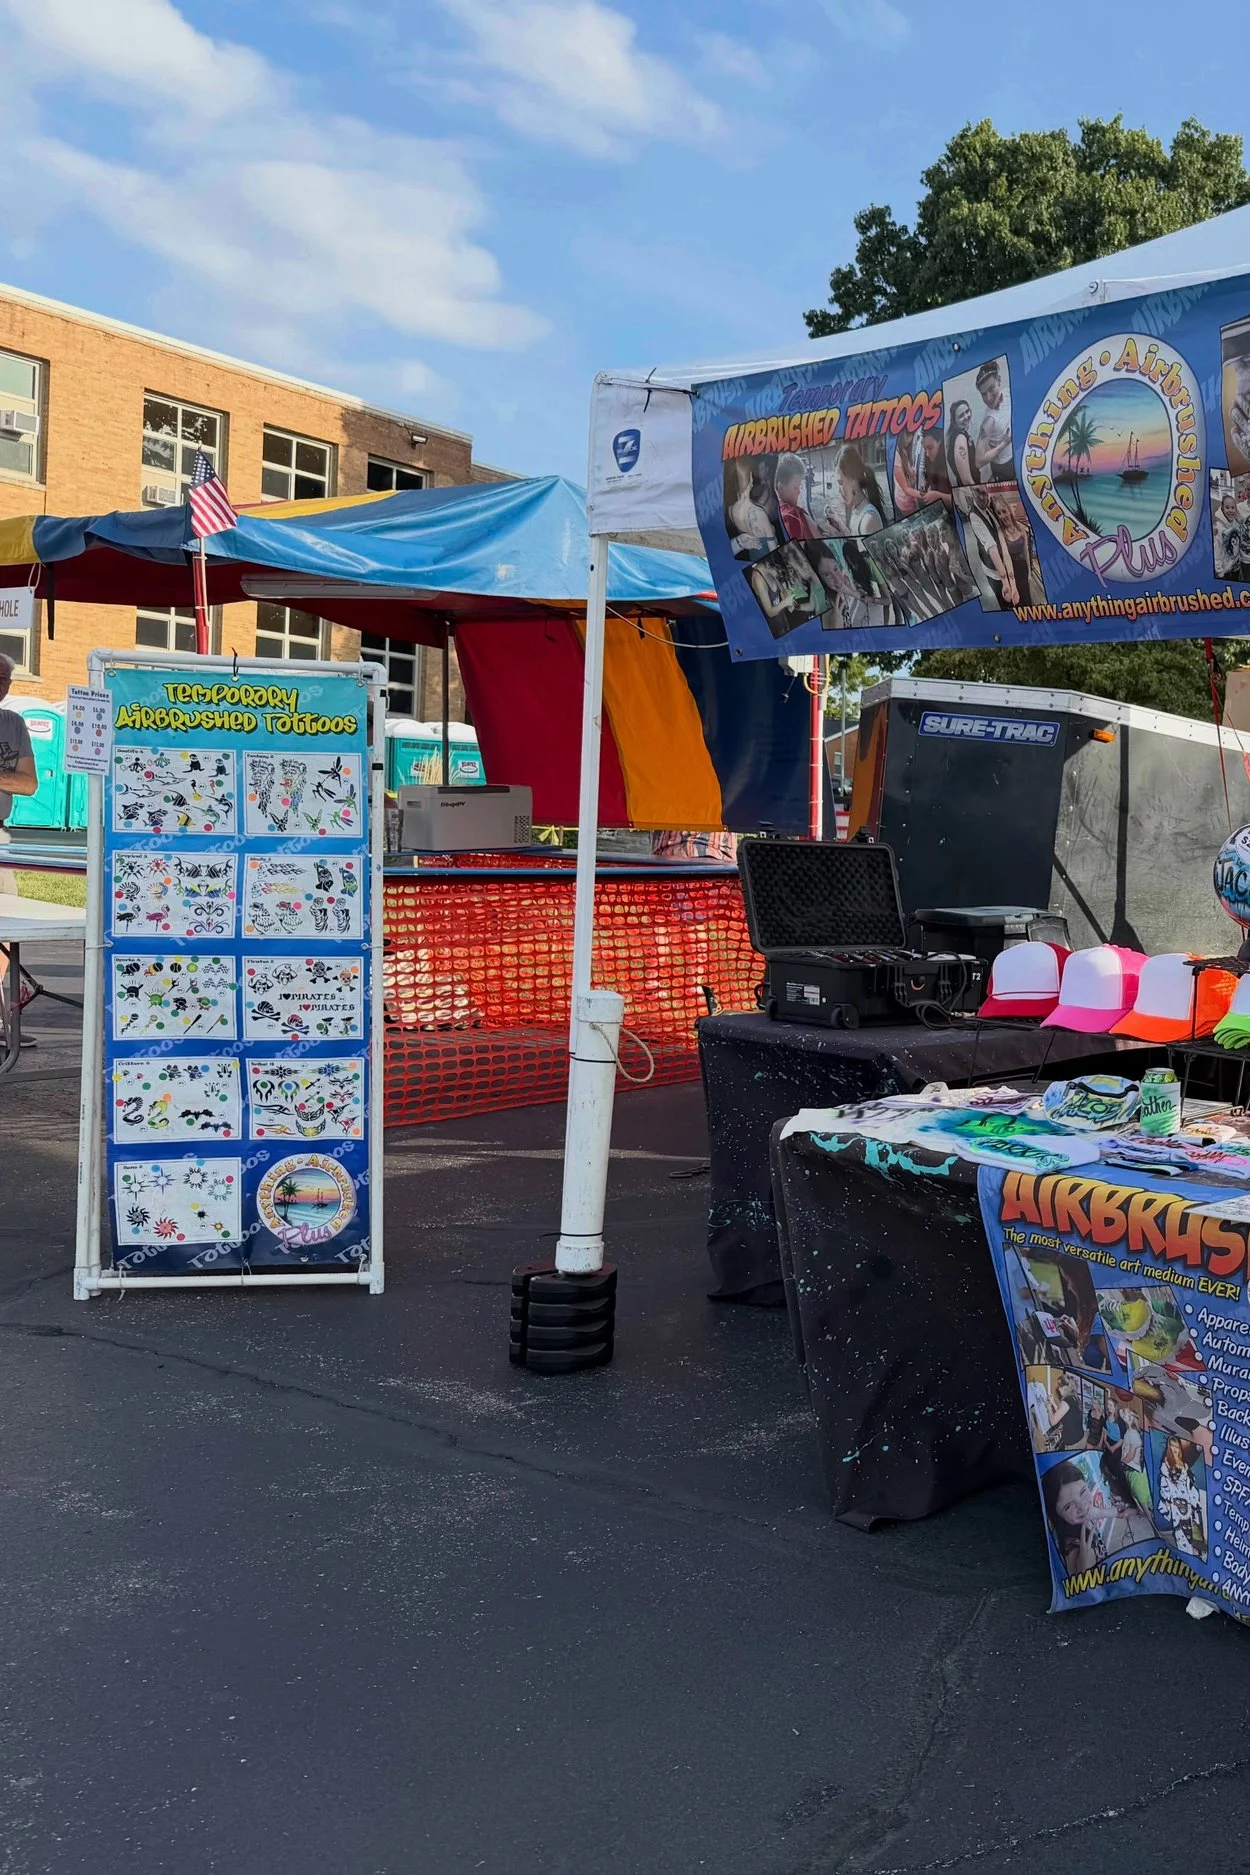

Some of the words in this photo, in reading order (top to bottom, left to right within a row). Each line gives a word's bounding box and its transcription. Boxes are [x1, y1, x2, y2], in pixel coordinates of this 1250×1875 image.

[779, 375, 889, 413] Temporary
[721, 404, 841, 463] AIRBRUSHED
[843, 388, 945, 441] TATTOOS
[1024, 355, 1099, 547] Anything
[1112, 336, 1202, 544] Airbrushed
[1080, 524, 1179, 588] Plus
[922, 715, 1055, 743] SURE-TRAC
[291, 992, 337, 1001] PIRATES
[310, 1003, 356, 1012] PIRATES
[1002, 1227, 1026, 1245] The
[1029, 1231, 1062, 1250] most
[1062, 1240, 1117, 1269] versatile
[1119, 1258, 1142, 1275] art
[1143, 1264, 1195, 1290] medium
[1199, 1276, 1241, 1301] EVER!
[1223, 1501, 1250, 1533] Temp
